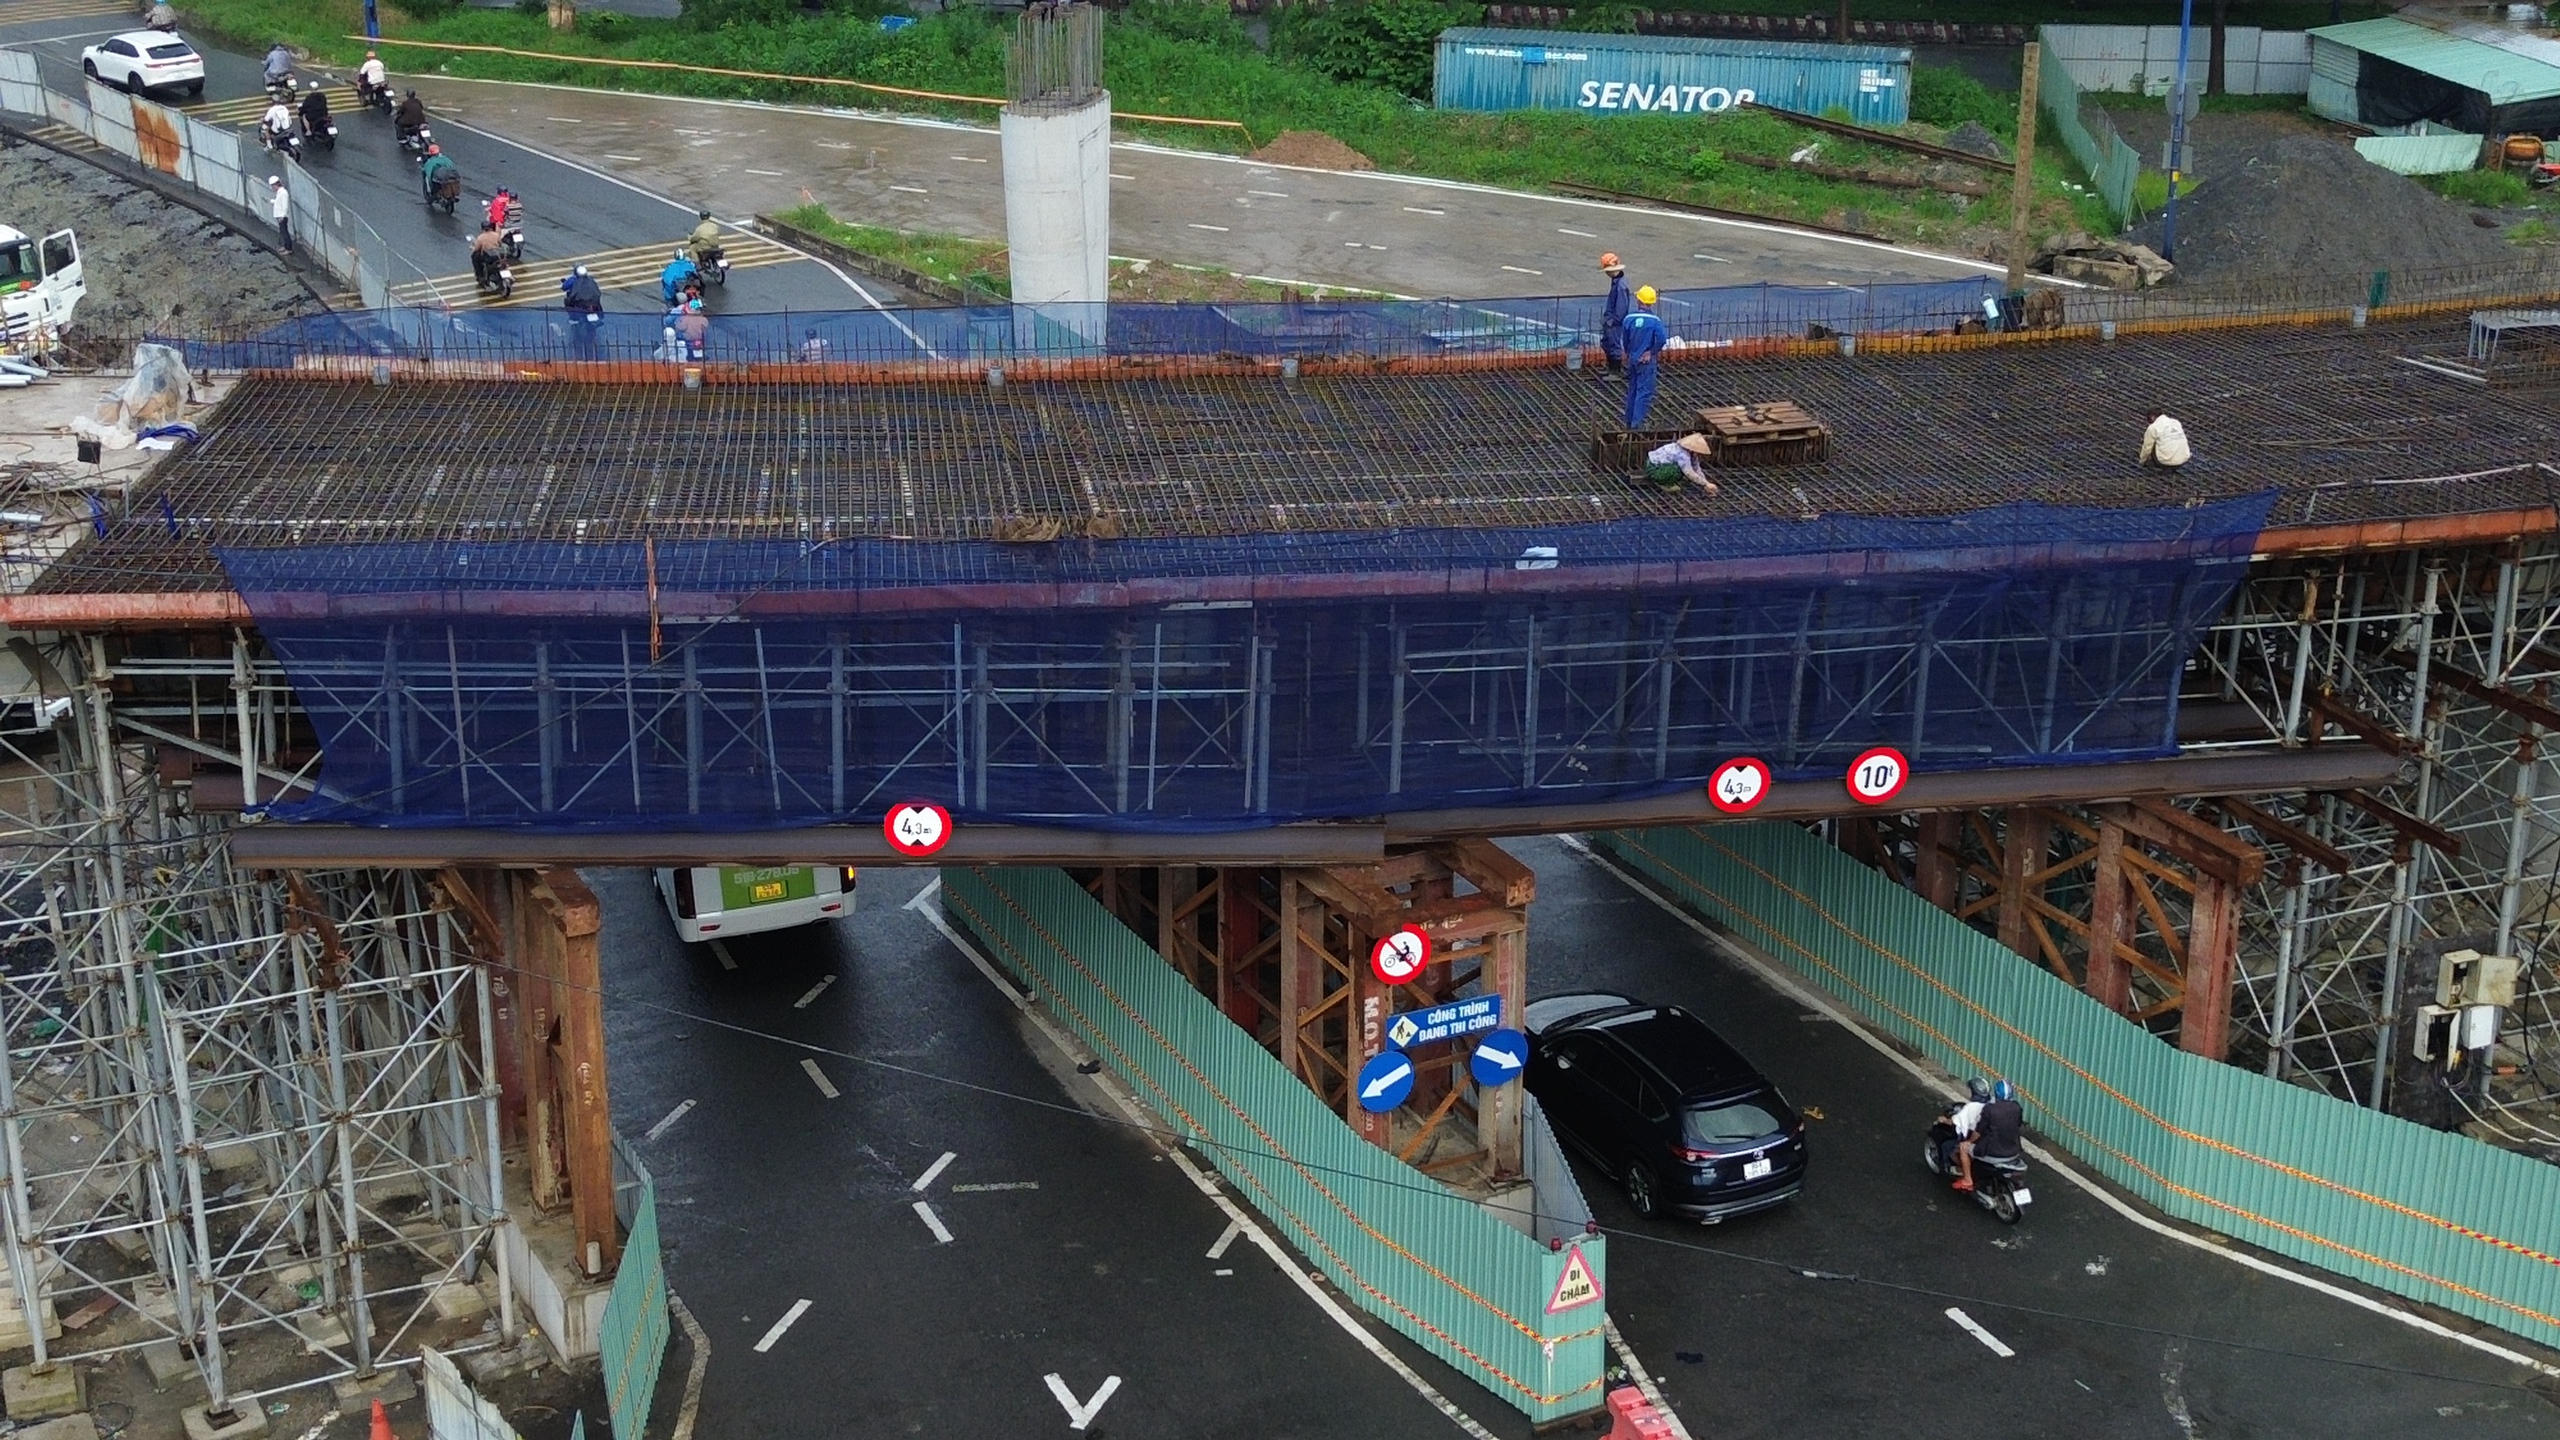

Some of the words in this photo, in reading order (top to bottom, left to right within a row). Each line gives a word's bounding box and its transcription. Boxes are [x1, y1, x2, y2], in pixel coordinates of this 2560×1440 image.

[1428, 1008, 1456, 1025] CÔNG
[1459, 1000, 1489, 1018] TRÌNH
[1450, 1020, 1466, 1035] THI
[1468, 1014, 1497, 1030] CÔNG
